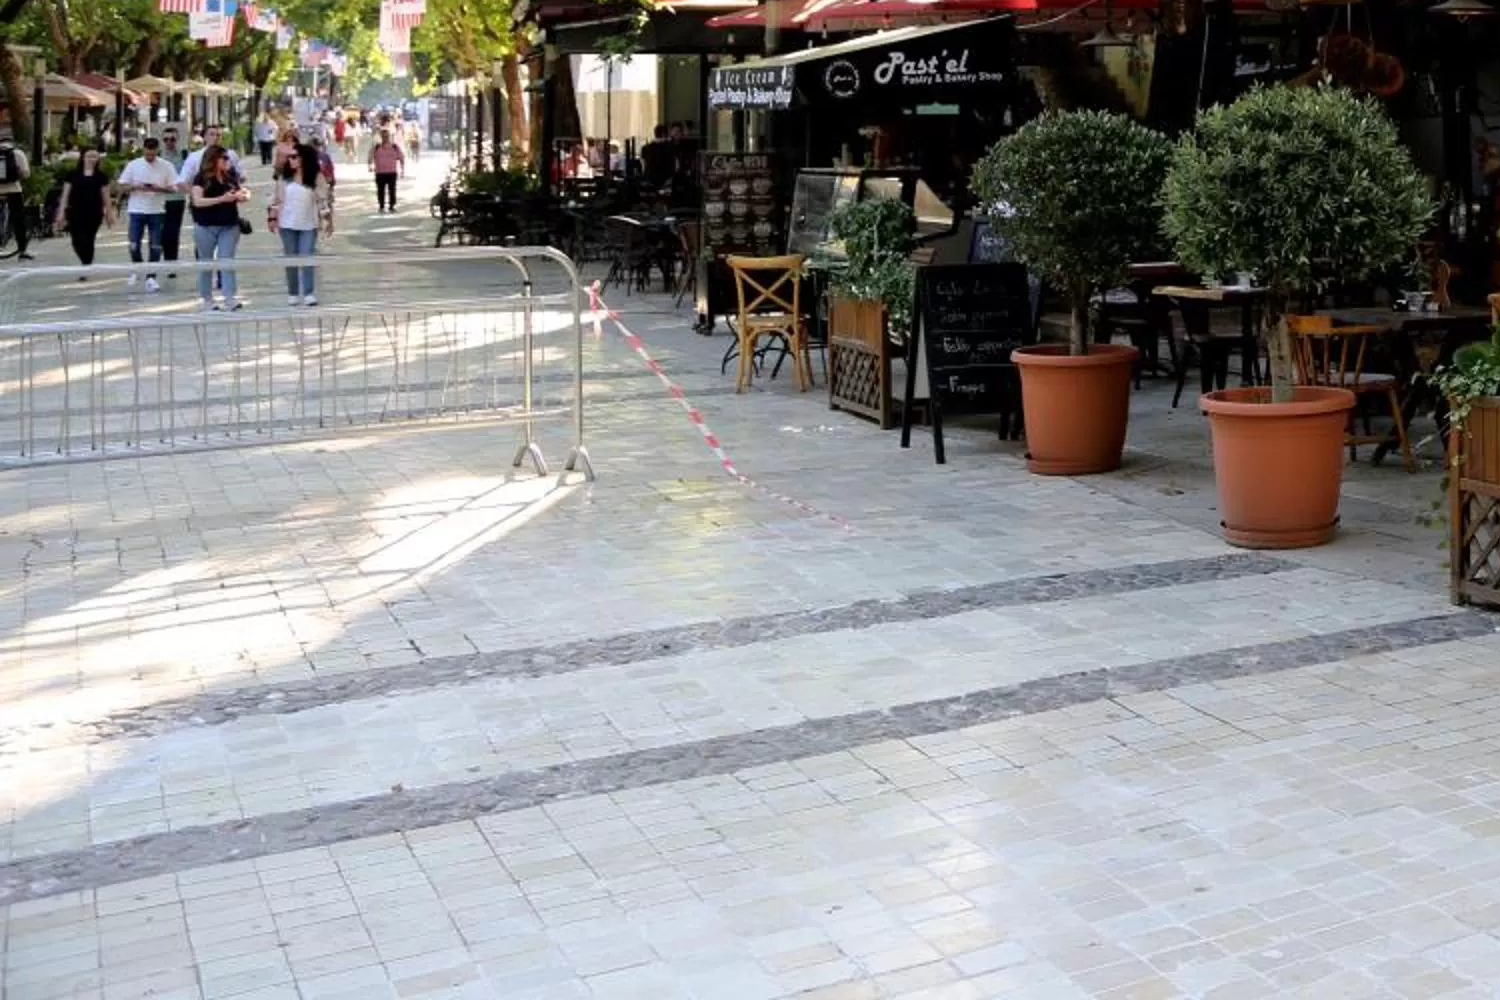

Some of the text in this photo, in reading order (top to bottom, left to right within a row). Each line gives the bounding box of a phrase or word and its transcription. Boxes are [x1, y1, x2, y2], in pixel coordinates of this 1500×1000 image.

[725, 69, 775, 86] Ice Cream
[901, 71, 1003, 85] Pastry & Bakery Shop
